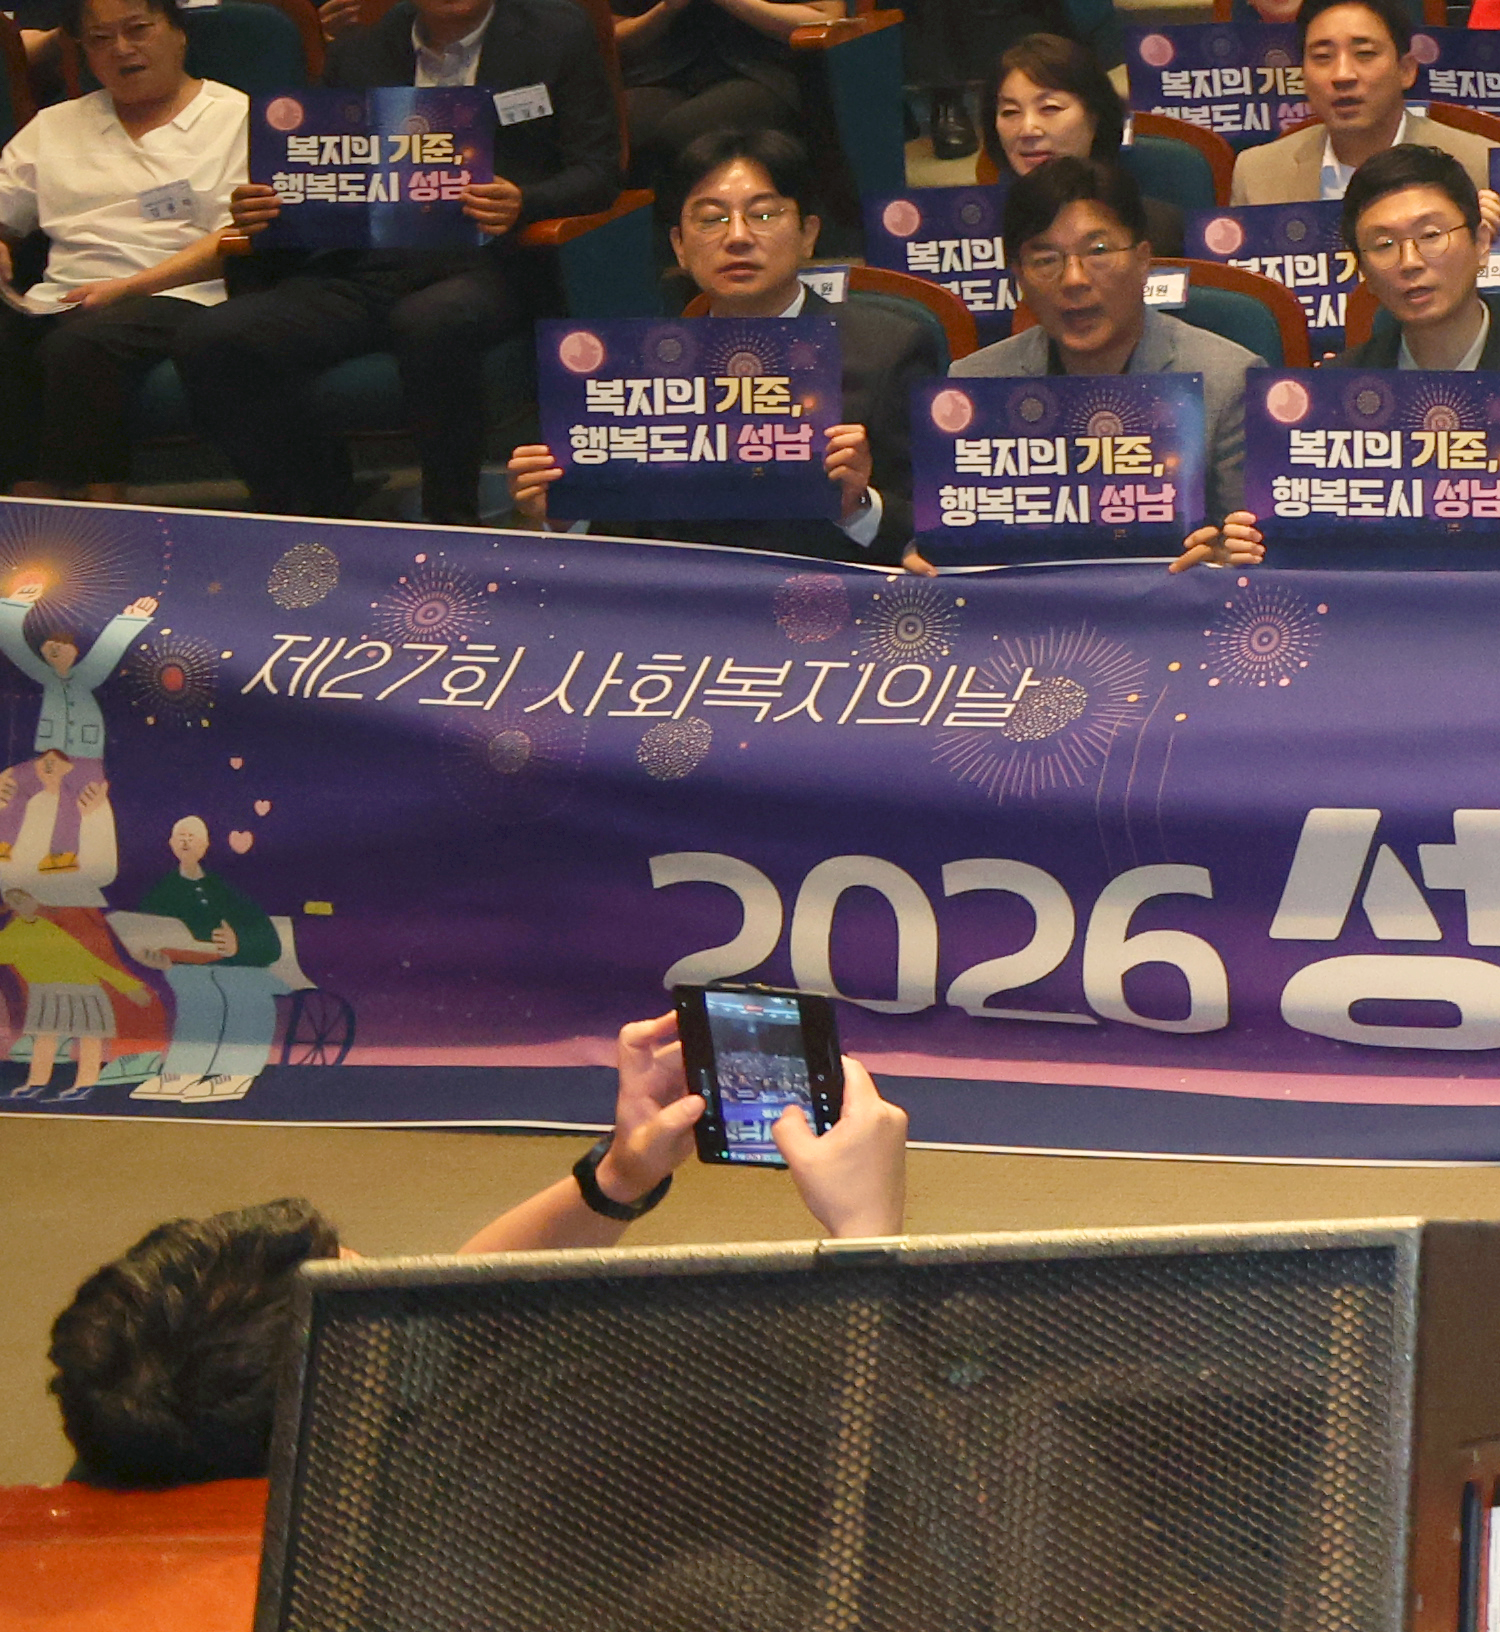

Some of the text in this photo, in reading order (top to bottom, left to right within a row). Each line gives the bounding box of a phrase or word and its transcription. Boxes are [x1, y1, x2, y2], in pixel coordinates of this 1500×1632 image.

[287, 135, 382, 166] 복지의
[273, 171, 399, 204] 행복도시
[587, 377, 802, 417] 복지의 기준,
[570, 424, 813, 463] 행복도시 성남
[956, 436, 1164, 477] 복지의 기준,
[1290, 430, 1498, 472] 복지의 기준,
[940, 484, 1176, 525] 행복도시 성남
[1273, 476, 1422, 517] 행복도시
[241, 634, 1041, 729] 제27회 사회복지의날
[650, 851, 1229, 1034] 2026
